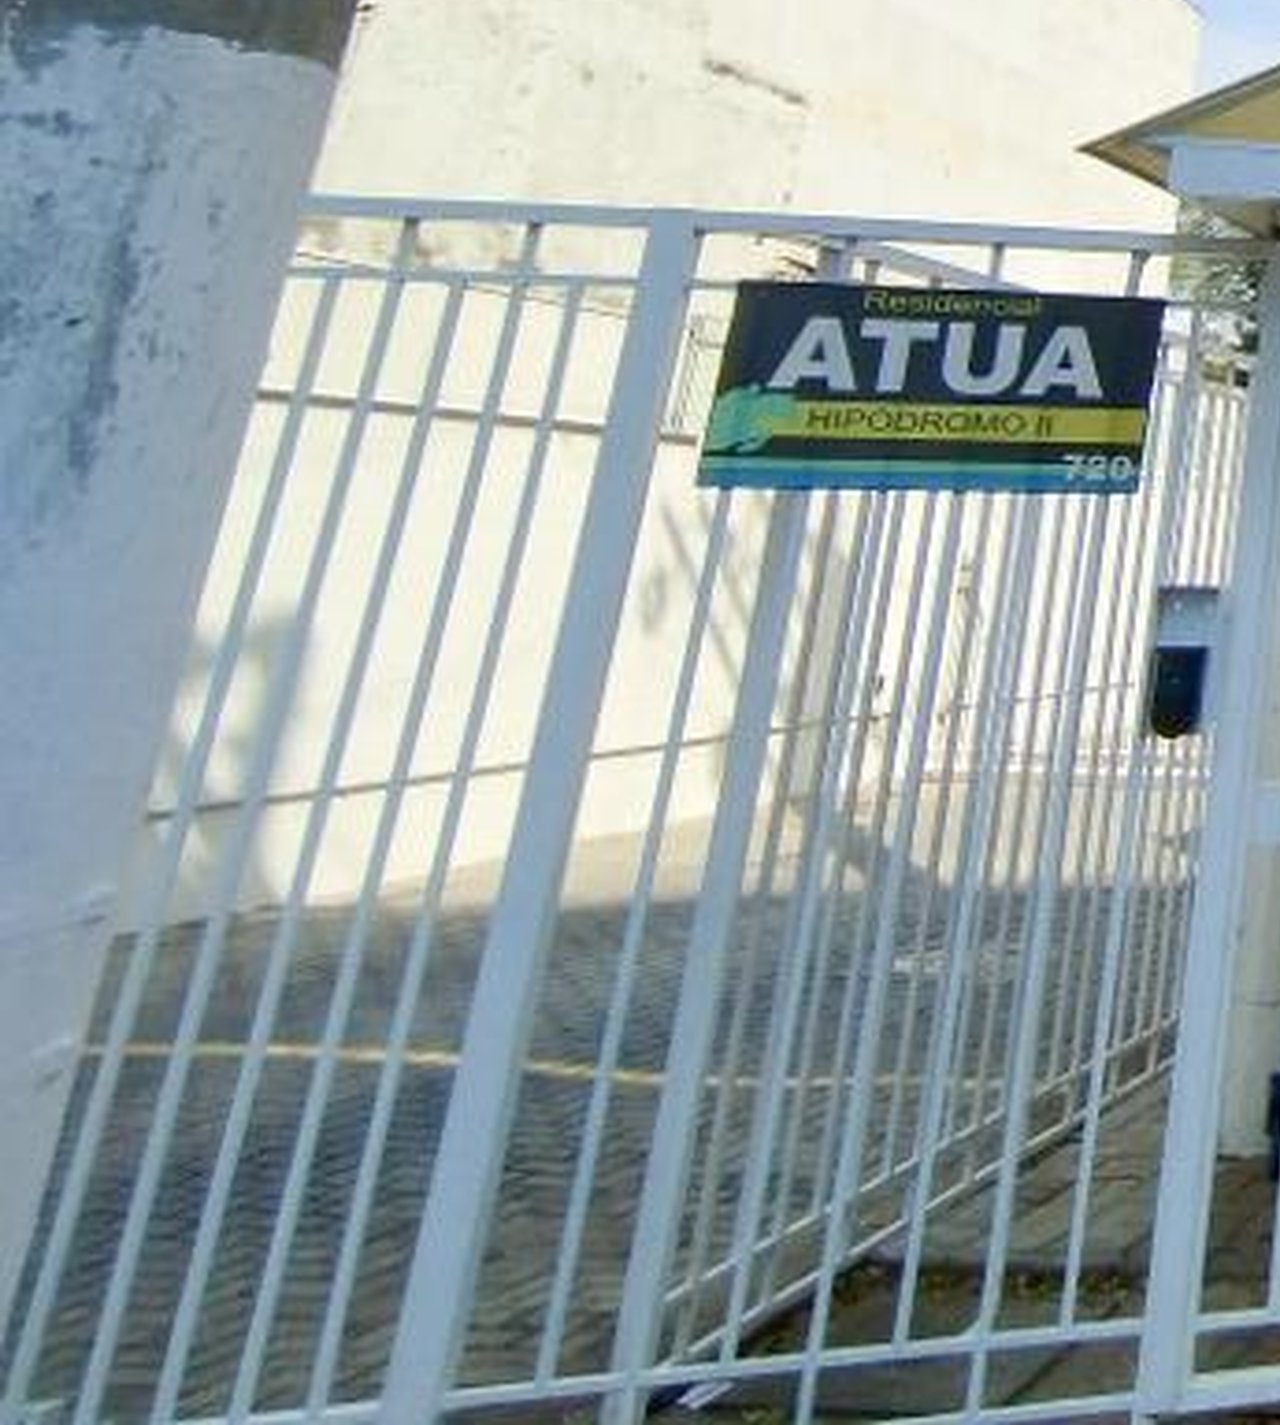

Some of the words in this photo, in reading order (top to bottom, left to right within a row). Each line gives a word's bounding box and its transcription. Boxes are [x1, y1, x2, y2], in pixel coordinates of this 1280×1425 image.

[863, 290, 1042, 318] Residencial
[767, 316, 1104, 399] ATUA
[1036, 413, 1055, 437] II
[1062, 453, 1134, 482] 720
